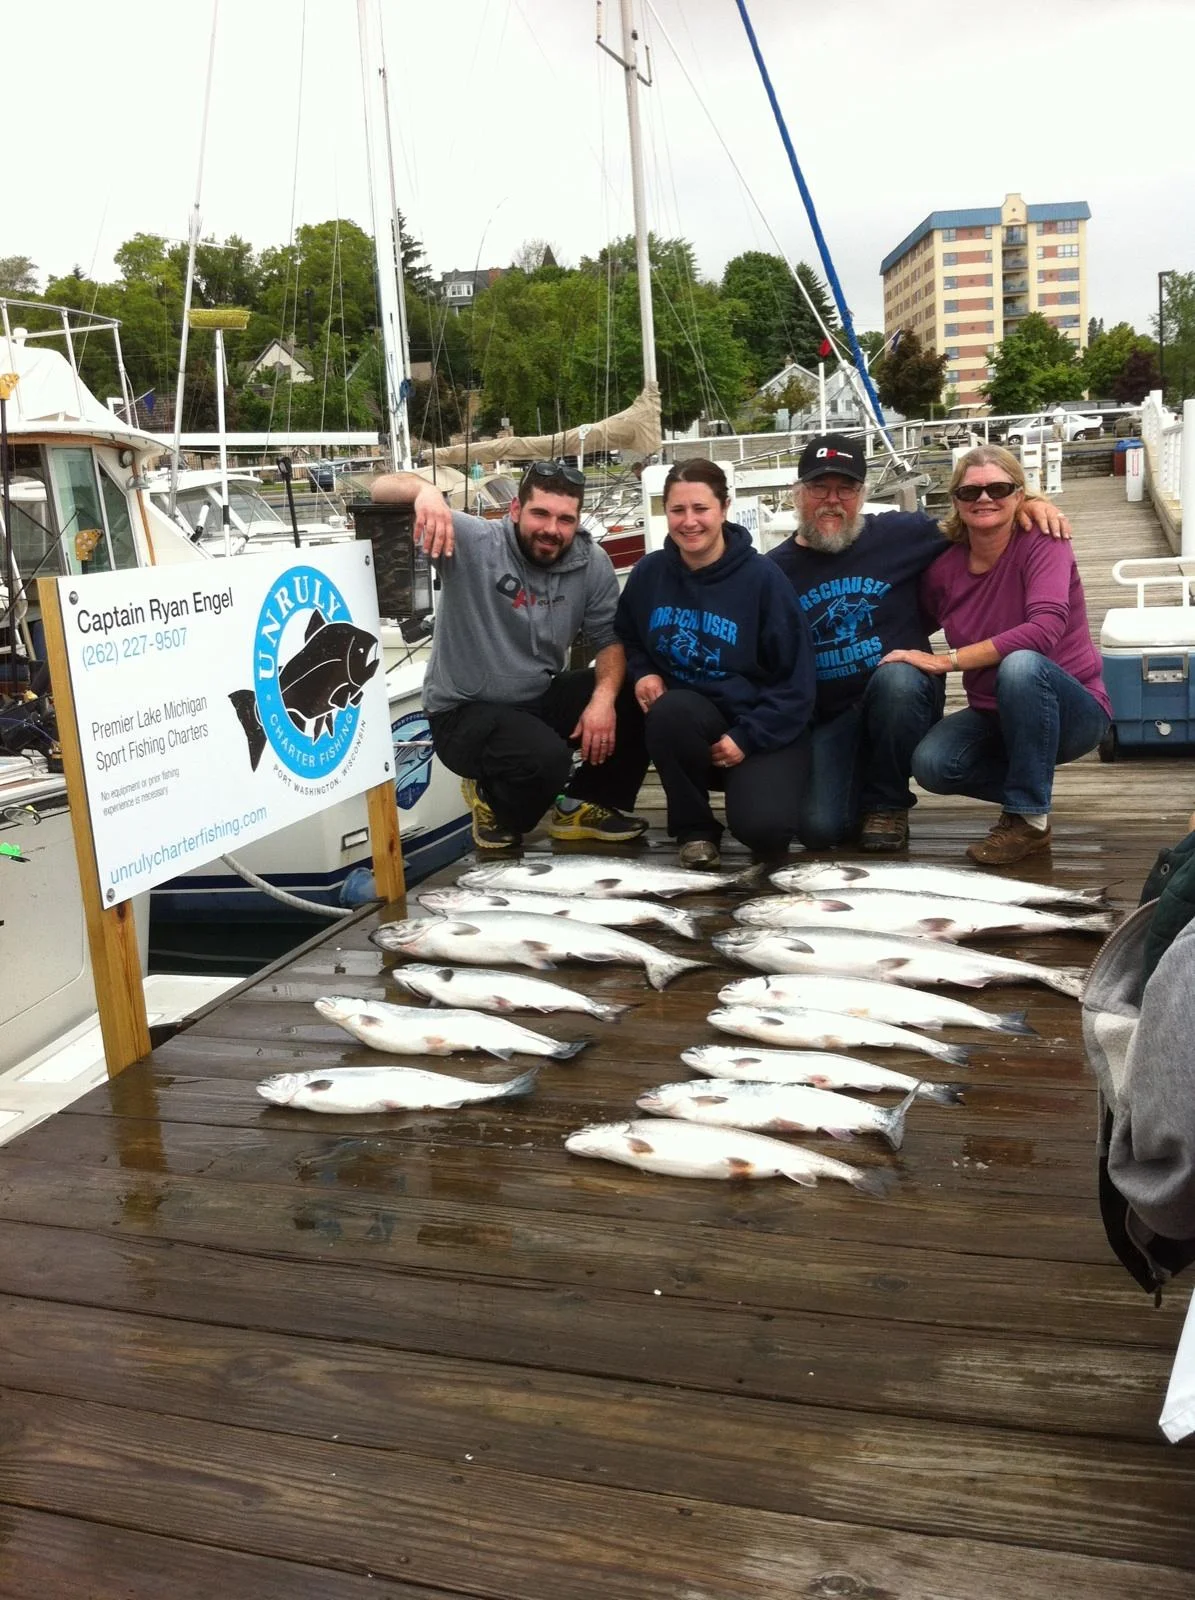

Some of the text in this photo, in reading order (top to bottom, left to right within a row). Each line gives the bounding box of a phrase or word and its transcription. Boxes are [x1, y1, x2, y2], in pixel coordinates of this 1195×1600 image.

[735, 508, 759, 530] RBOR
[77, 587, 234, 635] Captain Ryan Engel
[258, 575, 342, 681] UNRULY
[82, 627, 188, 672] (262) 227-9507
[91, 696, 208, 742] Premier Lake Michigan
[270, 712, 353, 767] CHARTER FISHING
[95, 723, 209, 772] Sport Fishing Charters
[273, 763, 292, 787] PORT
[342, 720, 366, 776] WISCONSIN
[100, 767, 180, 801] No equipment or prior fishing
[103, 798, 135, 817] experience
[141, 786, 169, 803] necessary
[110, 805, 268, 885] unrulycharterfishing.com
